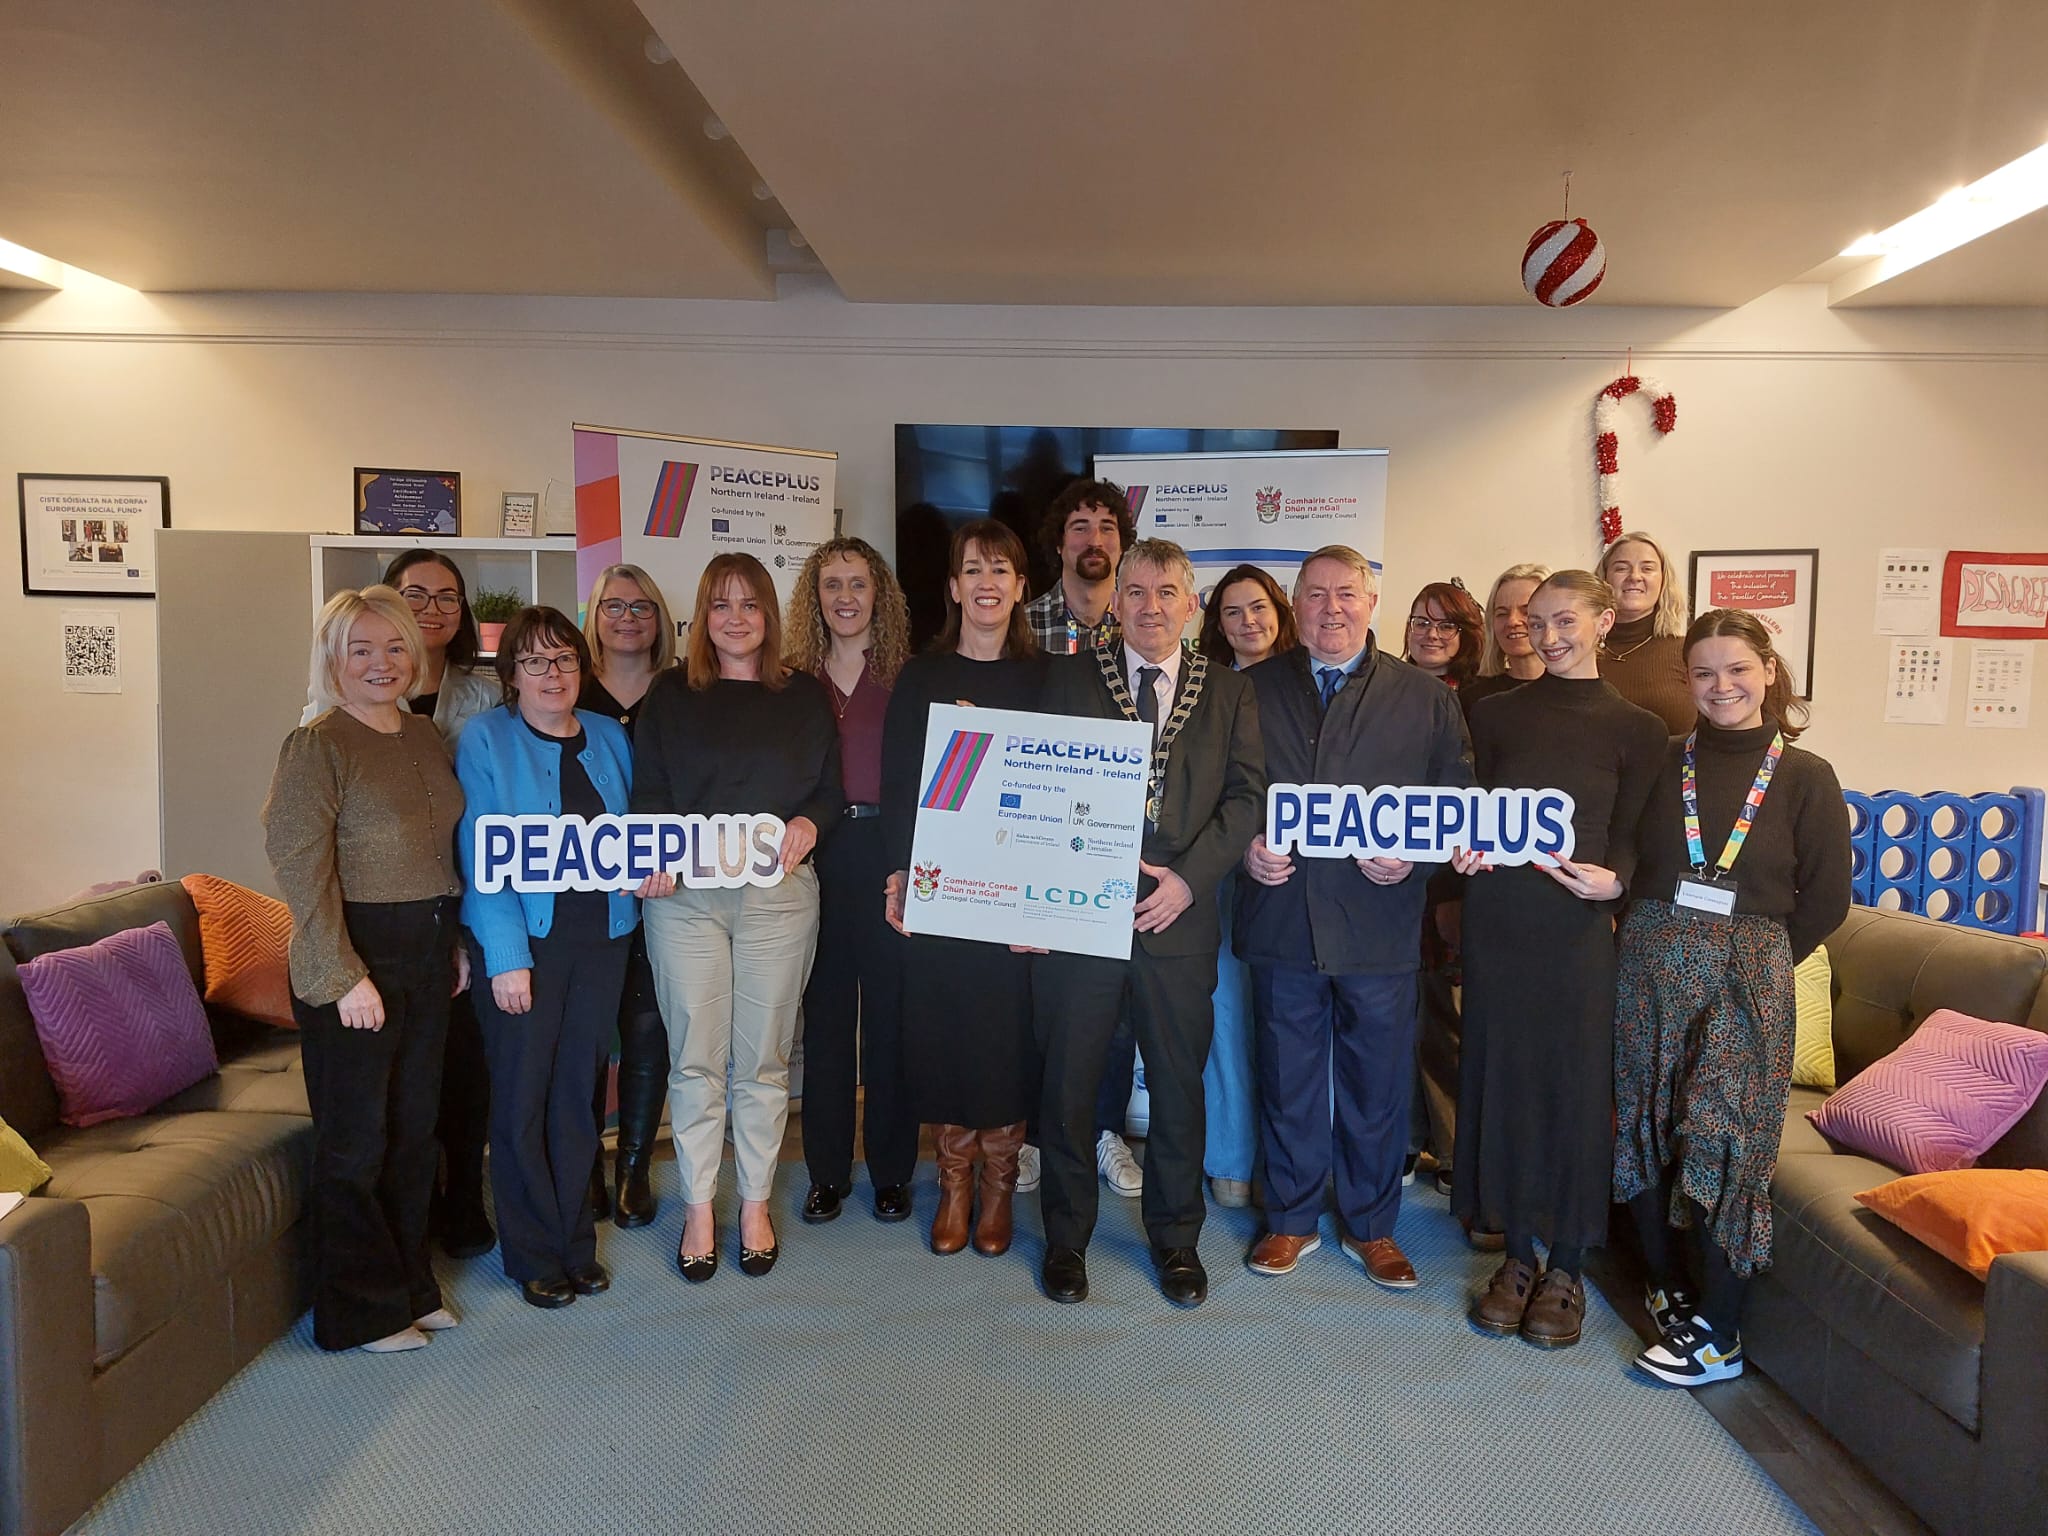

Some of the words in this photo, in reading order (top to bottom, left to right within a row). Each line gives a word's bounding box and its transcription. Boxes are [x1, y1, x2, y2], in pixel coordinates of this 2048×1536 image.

[710, 465, 820, 491] PEACEPLUS
[710, 487, 752, 498] Northern
[754, 491, 785, 501] Ireland
[792, 494, 820, 504] Ireland
[1156, 484, 1228, 494] PEACEPLUS
[1285, 497, 1326, 505] Comhairle
[45, 505, 86, 513] EUROPEAN
[711, 507, 744, 516] Co-funded
[711, 534, 744, 545] European
[746, 536, 766, 545] Union
[1959, 567, 2048, 618] DISAGREE
[1005, 735, 1143, 765] PEACEPLUS
[1004, 759, 1053, 772] Northern
[1055, 764, 1093, 776] Ireland
[1103, 768, 1142, 781] Ireland
[1001, 780, 1041, 791] Co-funded
[1042, 785, 1052, 793] by
[998, 809, 1037, 822] European
[1039, 814, 1063, 824] Union
[1275, 792, 1565, 855] PEACEPLUS
[1073, 817, 1085, 826] UK
[1086, 819, 1136, 832] Government
[485, 821, 780, 883] PEACEPLUS
[943, 876, 986, 888] Comhairle
[988, 882, 1018, 892] Contae
[941, 894, 968, 903] Donegal
[969, 897, 991, 906] County
[993, 900, 1017, 909] Council
